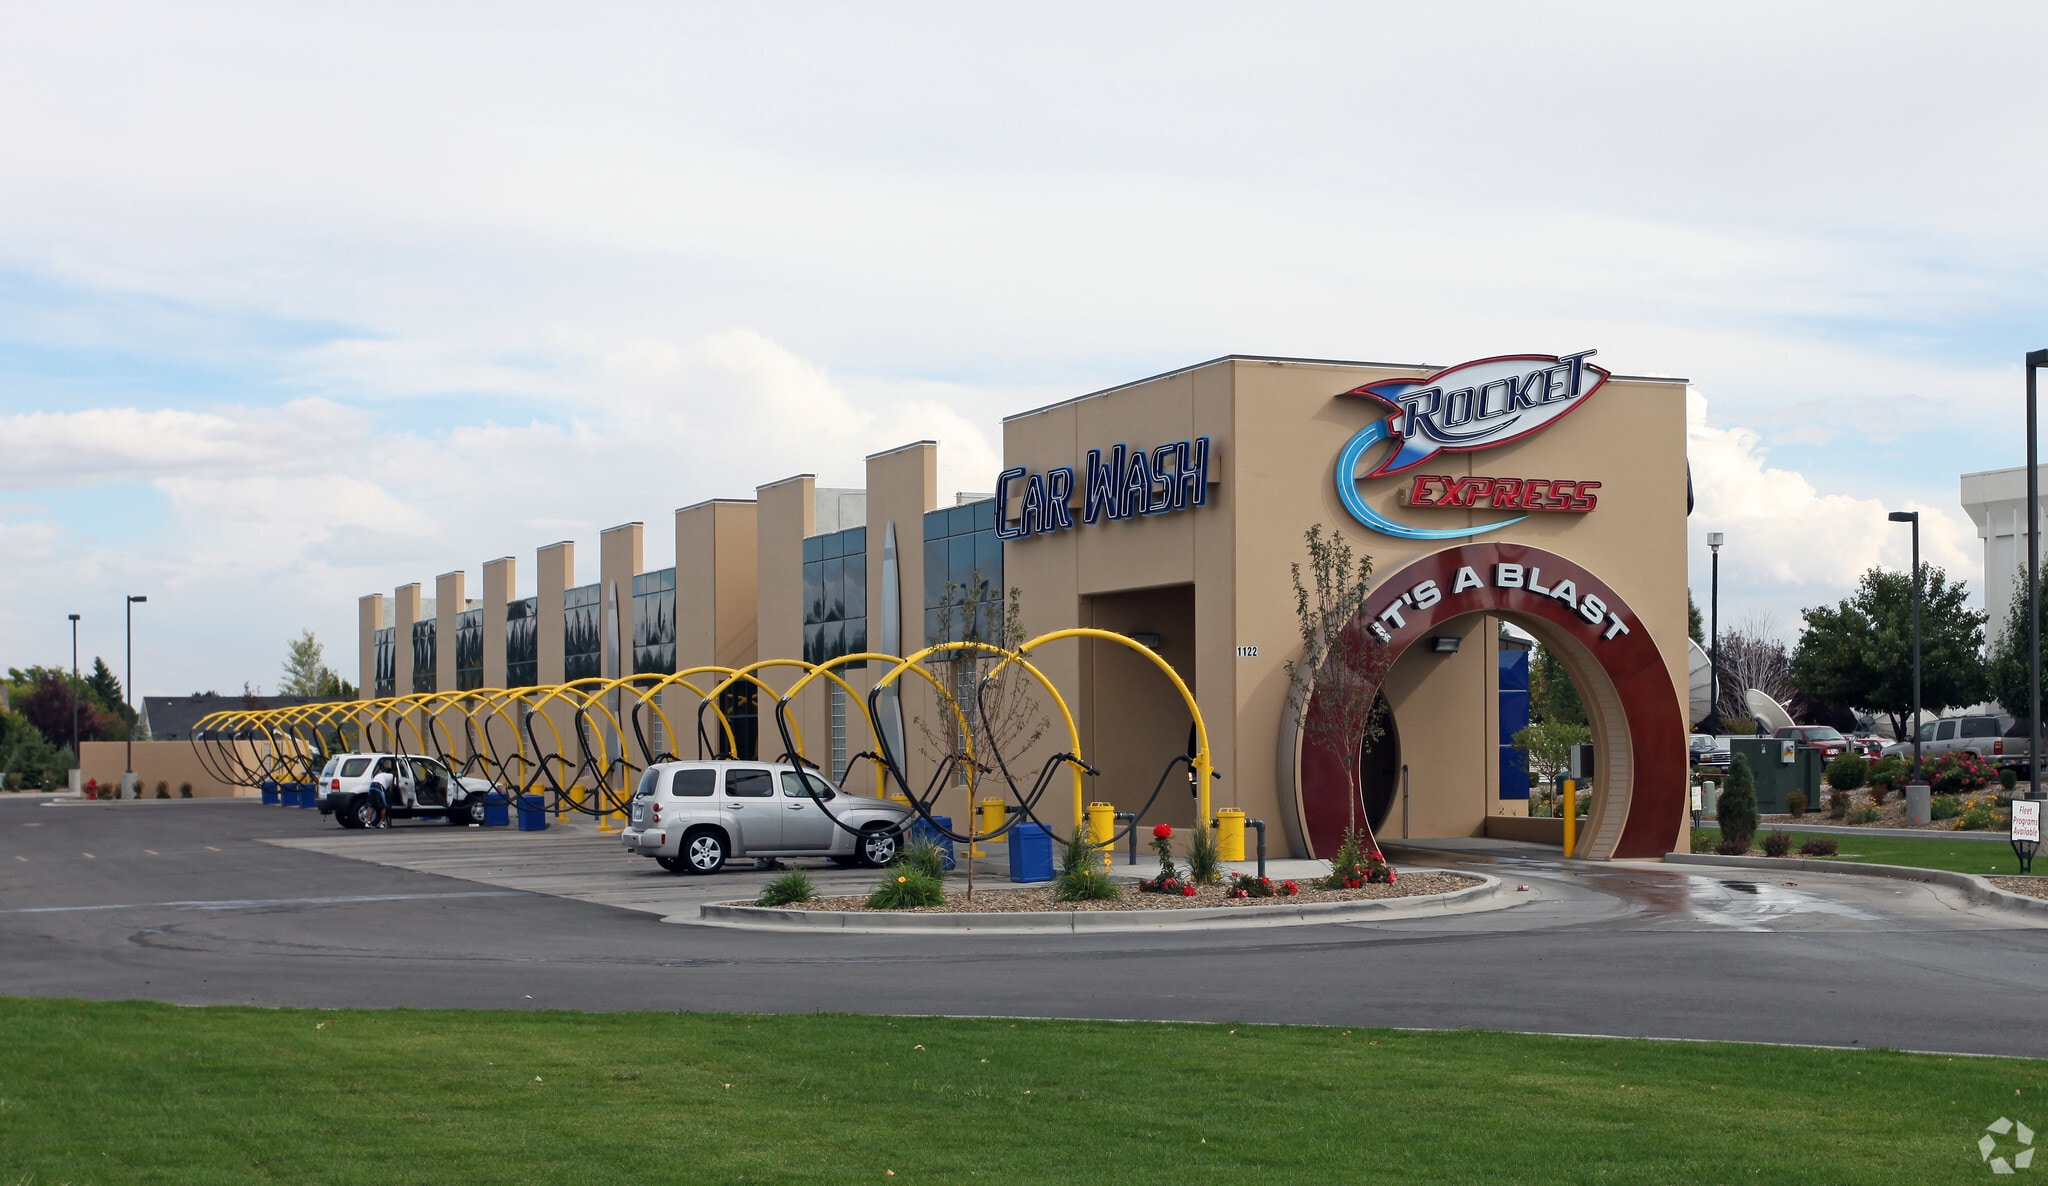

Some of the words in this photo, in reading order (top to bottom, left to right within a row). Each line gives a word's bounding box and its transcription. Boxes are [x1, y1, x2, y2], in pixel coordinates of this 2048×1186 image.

[1399, 349, 1597, 443] ROCKET
[995, 466, 1075, 541] CAR
[1083, 435, 1209, 525] WASH
[1410, 475, 1602, 511] EXPRESS
[1369, 579, 1442, 644] IT'S
[1452, 565, 1485, 594] A
[1495, 563, 1630, 641] BLAST
[1237, 646, 1257, 657] 1122
[2013, 816, 2038, 827] Programs
[2019, 806, 2032, 815] Fleet
[2013, 827, 2038, 837] Available
